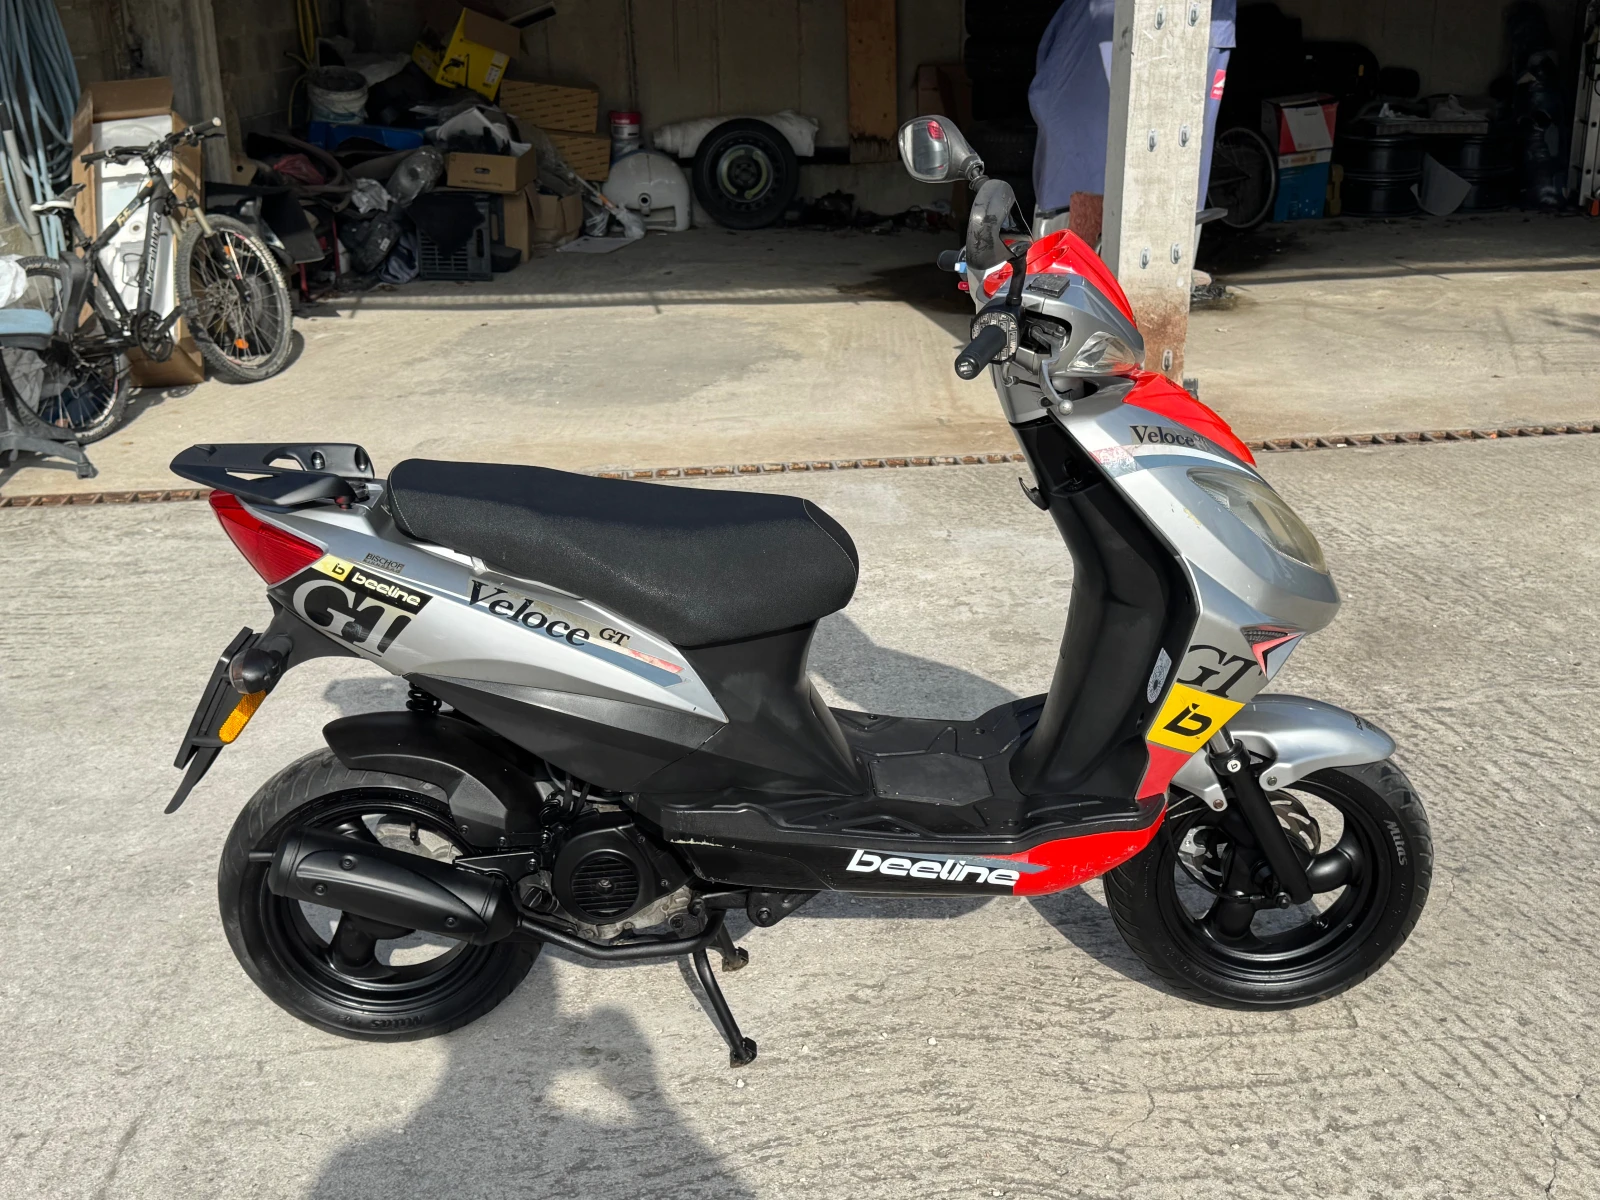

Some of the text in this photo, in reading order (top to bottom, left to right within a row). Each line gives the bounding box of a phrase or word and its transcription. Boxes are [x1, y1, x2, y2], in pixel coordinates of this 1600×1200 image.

[1130, 425, 1195, 447] Veloce
[366, 552, 405, 569] BISCHOF
[351, 571, 421, 606] beeline
[293, 579, 418, 658] GT
[467, 579, 631, 646] Veloce GT
[1177, 644, 1262, 698] GT
[1383, 819, 1408, 866] Mitas
[846, 849, 1020, 885] beeline
